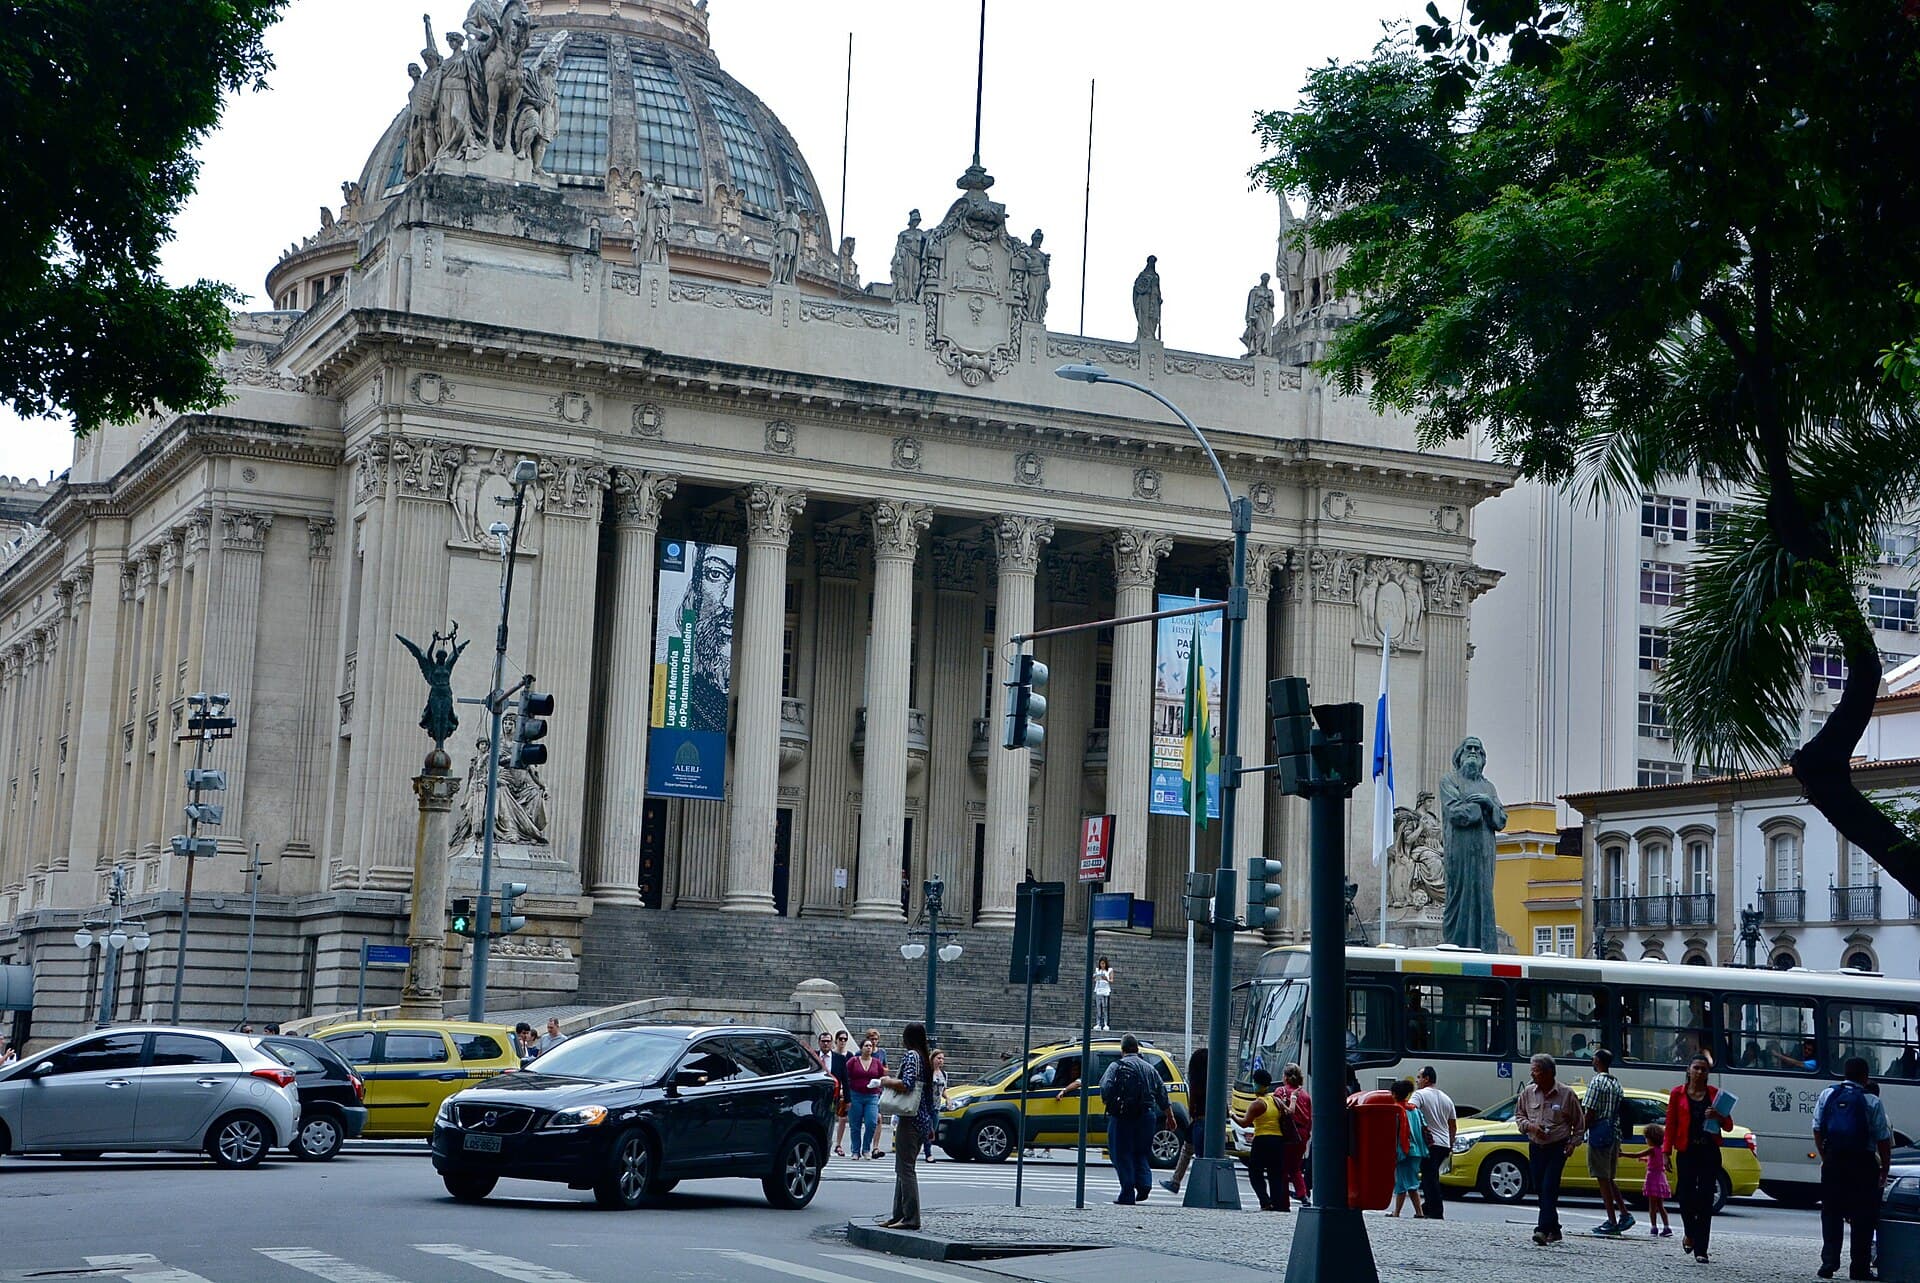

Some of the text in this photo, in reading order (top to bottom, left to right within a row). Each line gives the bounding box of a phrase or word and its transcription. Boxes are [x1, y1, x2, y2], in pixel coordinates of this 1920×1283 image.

[667, 651, 679, 726] Lugar de Memória
[679, 623, 692, 727] do Parlamento Brasileiro
